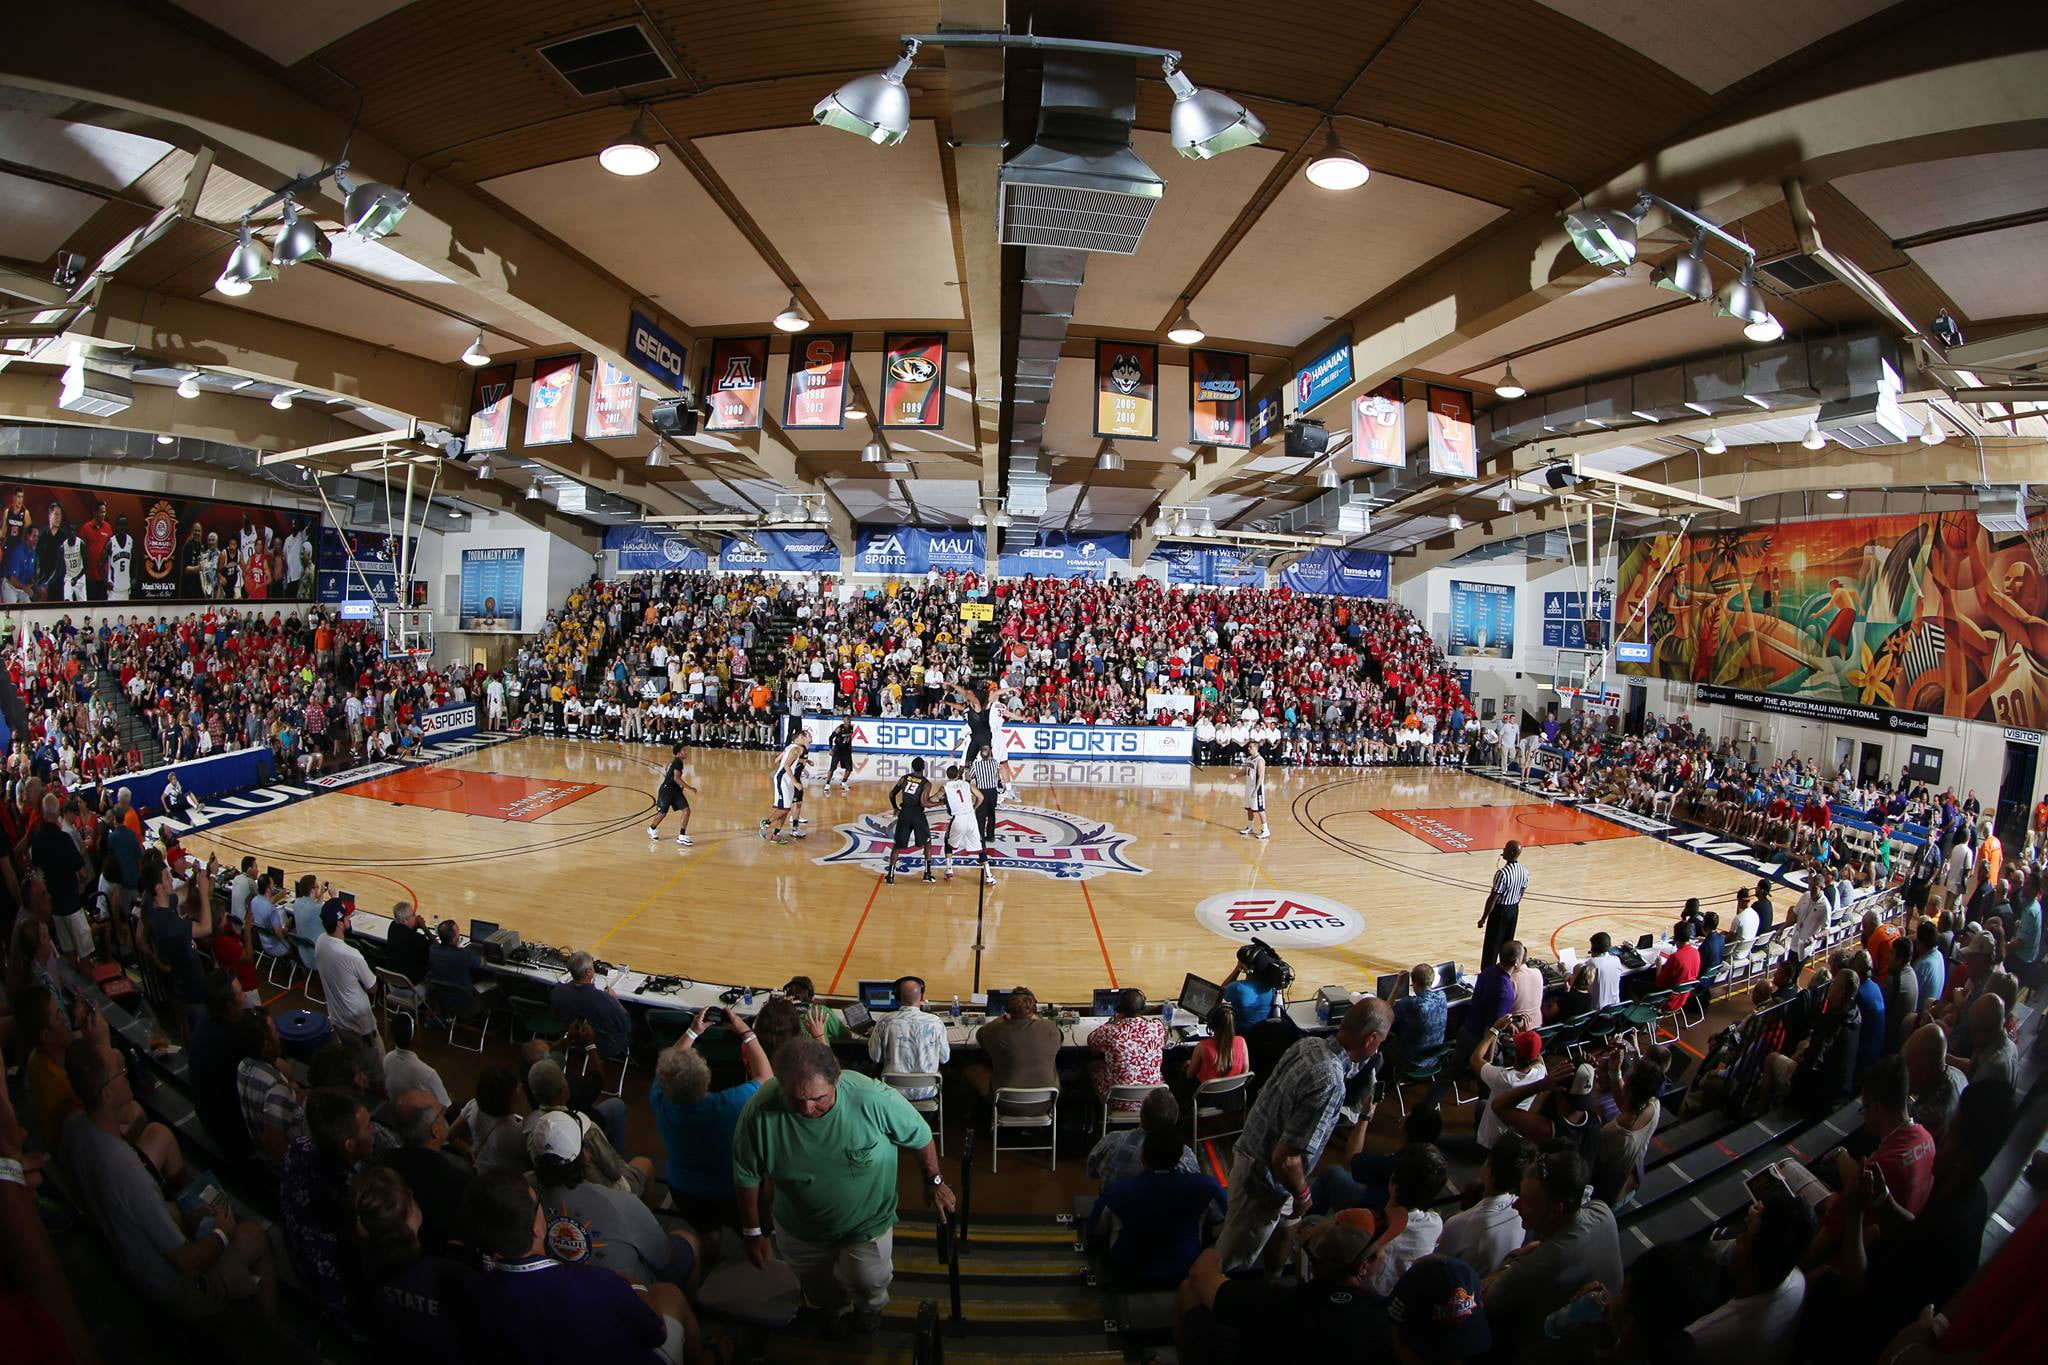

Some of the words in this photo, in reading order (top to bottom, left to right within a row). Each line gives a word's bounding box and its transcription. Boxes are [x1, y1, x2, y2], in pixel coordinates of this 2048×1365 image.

[635, 327, 682, 376] GEICO
[804, 340, 834, 374] S
[1312, 346, 1348, 381] HAWAIIAN
[718, 356, 755, 391] A
[807, 375, 826, 386] 1990
[806, 389, 825, 400] 1998
[806, 402, 824, 413] 2013
[902, 402, 922, 413] 1989
[1116, 398, 1136, 410] 2005
[724, 405, 744, 416] 2000
[605, 413, 621, 425] 2011
[1116, 412, 1136, 423] 2010
[1210, 420, 1230, 431] 2006
[784, 544, 824, 553] PROGRESSI
[867, 535, 905, 554] EA
[929, 538, 974, 553] MAUI
[468, 550, 501, 561] TOURNAMENT
[727, 552, 767, 564] adidas
[1019, 548, 1064, 558] GEICO
[865, 555, 906, 565] SPORTS
[1301, 568, 1327, 576] REGENCY
[1344, 567, 1367, 576] hmsa
[1459, 583, 1485, 593] TOURNAMENT
[345, 605, 371, 614] GEICO
[1620, 648, 1648, 657] GEICO
[1629, 676, 1647, 684] HOME
[1735, 693, 1754, 702] HOME
[1754, 696, 1764, 704] OF
[1765, 697, 1779, 705] THE
[1787, 701, 1808, 710] SPORTS
[1808, 703, 1828, 712] MAUI
[1828, 706, 1880, 720] INVITATIONAL
[422, 717, 436, 731] EA
[435, 709, 474, 728] SPORTS
[877, 725, 962, 748] SPORT
[1034, 729, 1138, 751] SPORTS
[1163, 736, 1176, 744] EA
[2006, 729, 2040, 742] VISITOR
[904, 781, 920, 795] 13
[498, 787, 561, 811] LAHAINA
[508, 802, 544, 817] CIVIC
[541, 785, 586, 804] CENTER
[957, 789, 964, 803] 1
[1392, 812, 1423, 826] CIVIC
[1419, 826, 1469, 849] CENTER
[1416, 815, 1475, 842] LAHAINA
[1225, 900, 1335, 922] EA
[1229, 918, 1346, 933] SPORTS
[550, 1239, 587, 1249] MAUI
[384, 1286, 440, 1317] STATE
